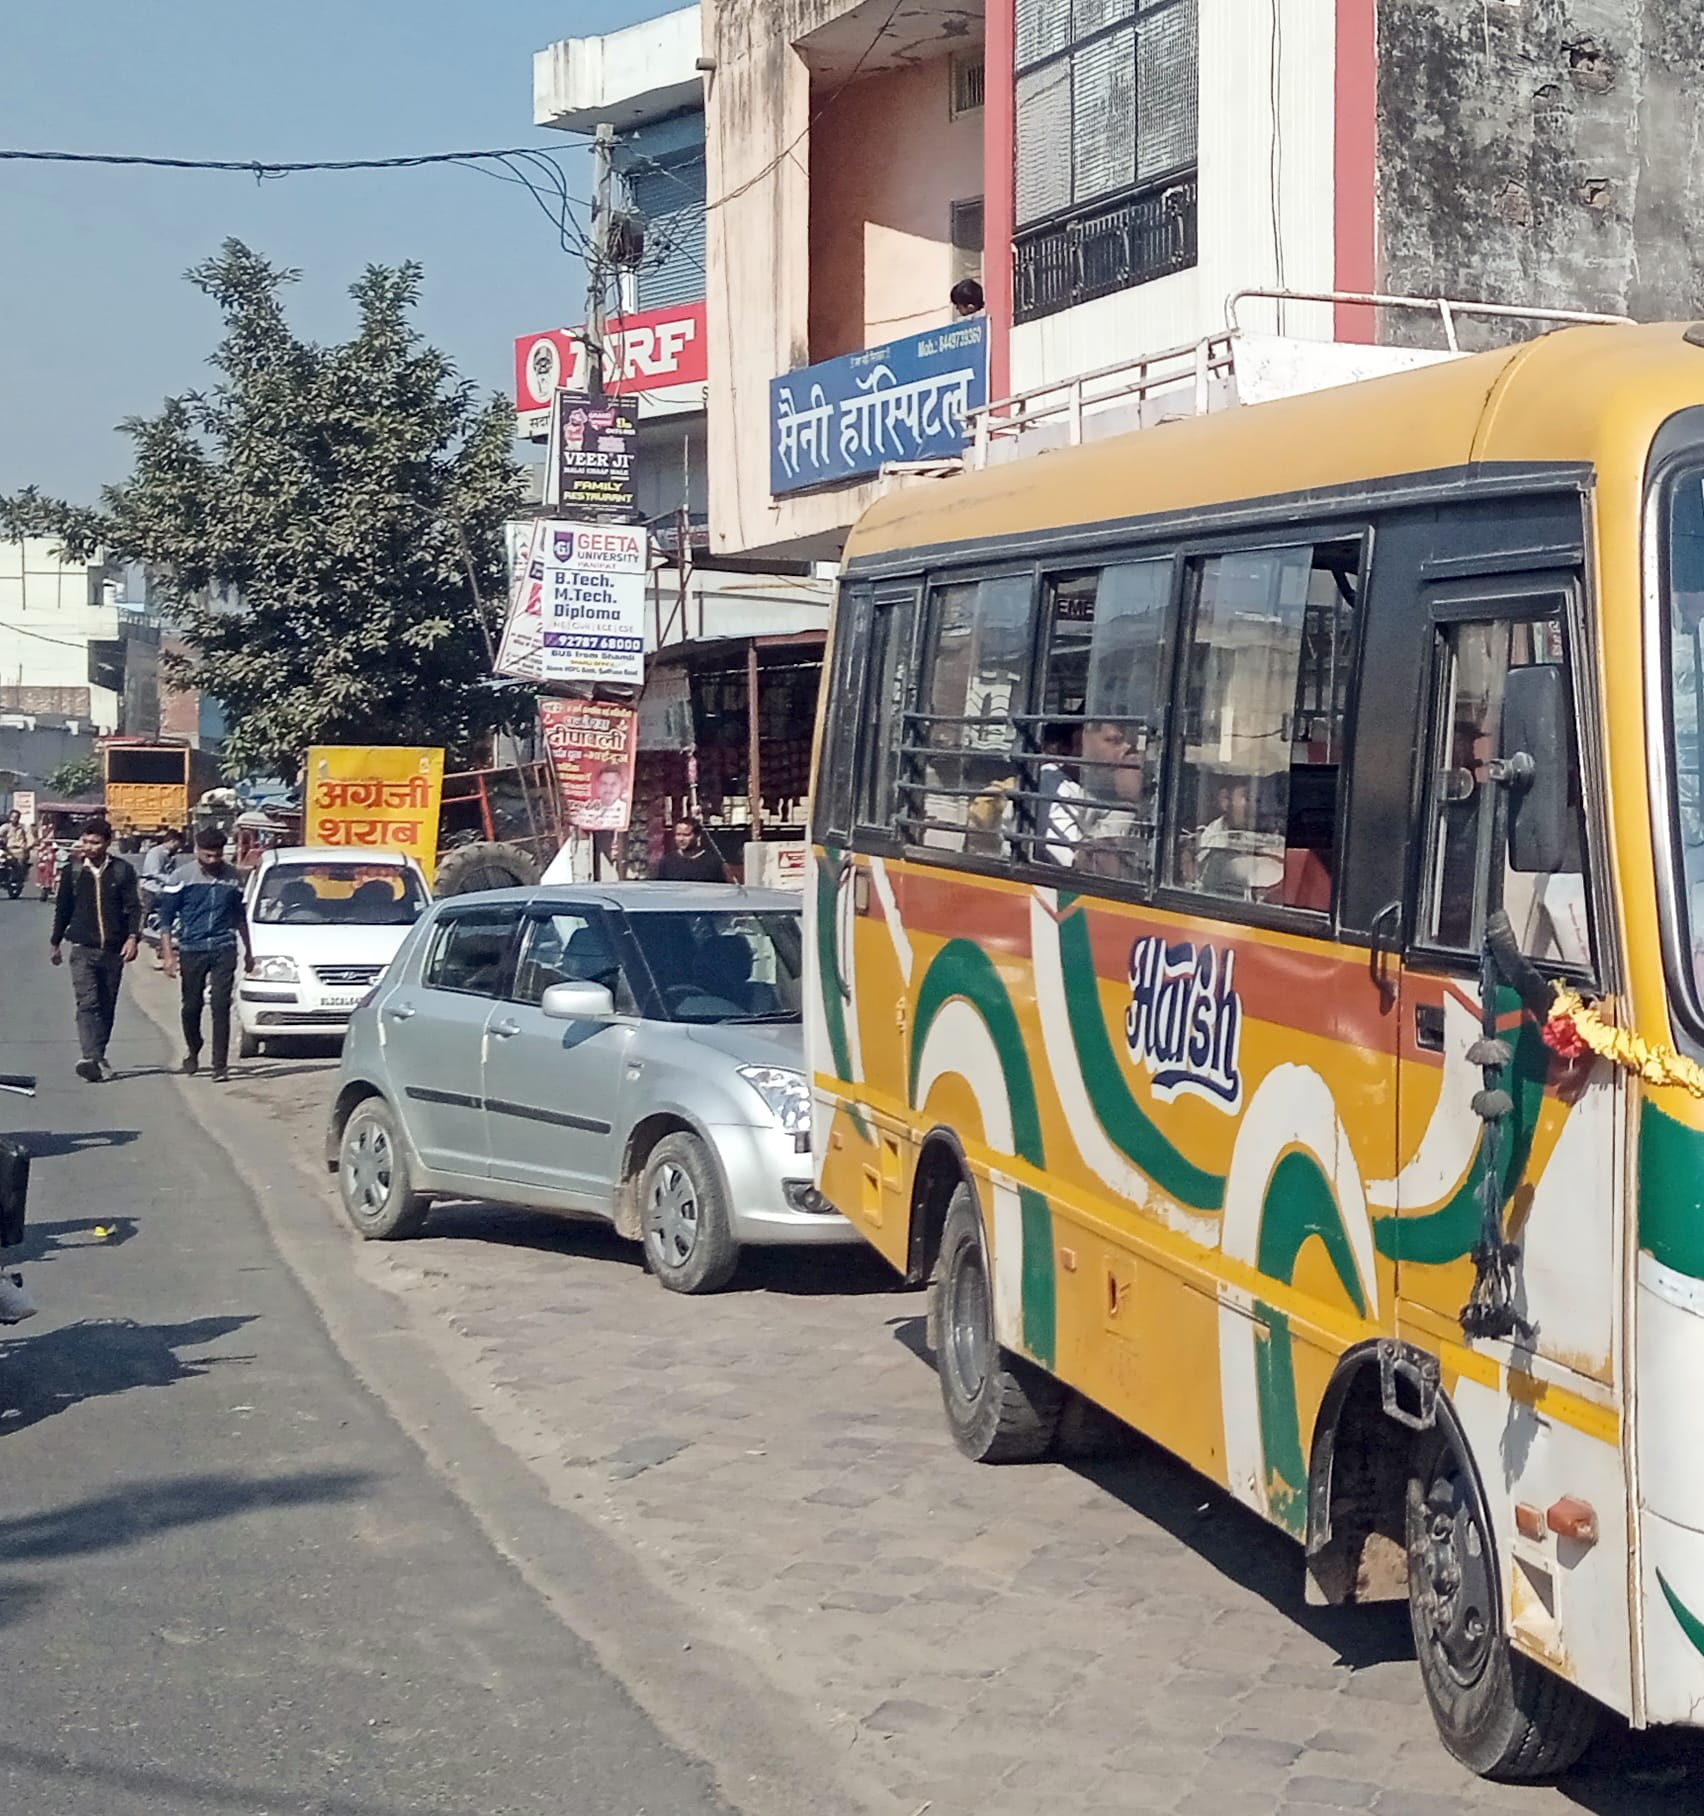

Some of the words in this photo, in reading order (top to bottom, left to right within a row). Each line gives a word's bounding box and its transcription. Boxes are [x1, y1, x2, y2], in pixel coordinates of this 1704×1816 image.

[777, 383, 835, 478] सैनी
[563, 451, 609, 467] VEER
[573, 480, 623, 492] FAMILY
[577, 533, 639, 553] GEETA
[577, 551, 639, 563] UNIVERSITY
[555, 572, 615, 588] B.Tech.
[554, 587, 618, 604] M.Tech.
[554, 603, 621, 621] Diploma
[317, 818, 424, 846] शराब
